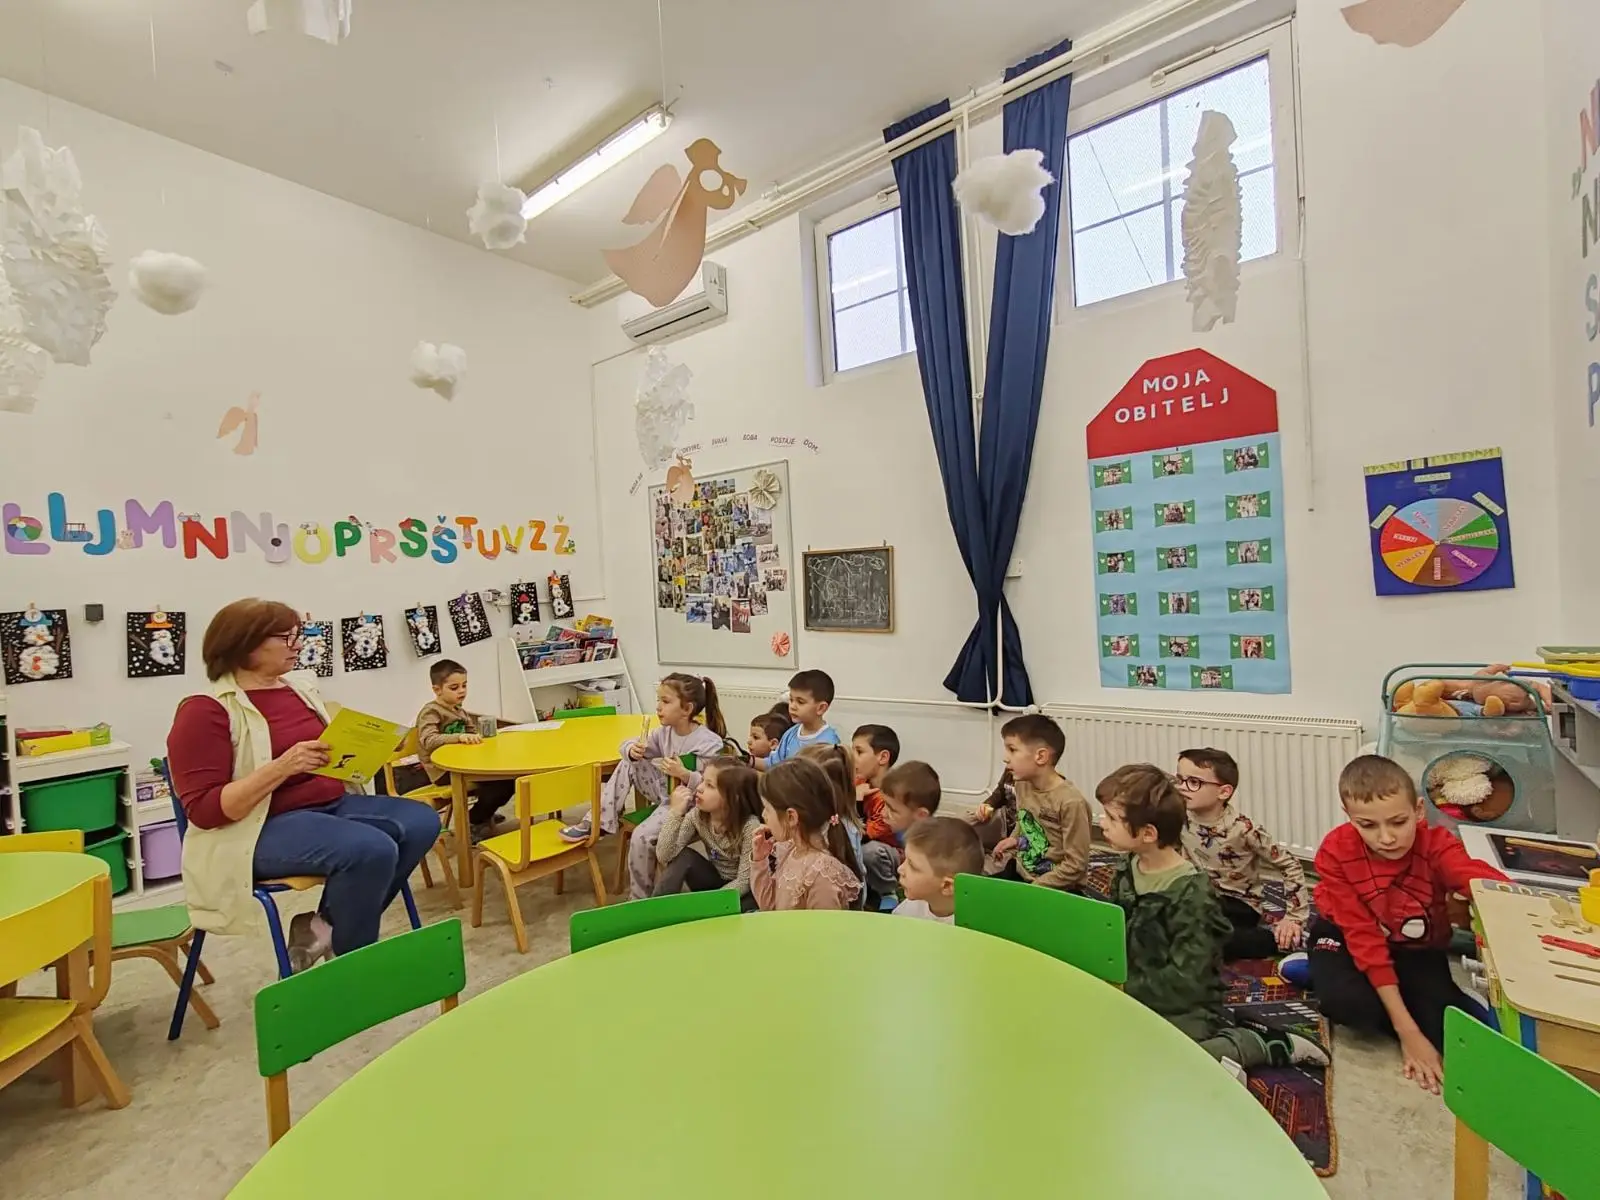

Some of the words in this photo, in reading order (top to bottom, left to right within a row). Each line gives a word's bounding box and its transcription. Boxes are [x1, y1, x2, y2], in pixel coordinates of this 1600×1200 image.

[1142, 367, 1212, 395] MOJA
[1114, 387, 1230, 424] OBITELJ
[770, 436, 796, 445] POSTAJE
